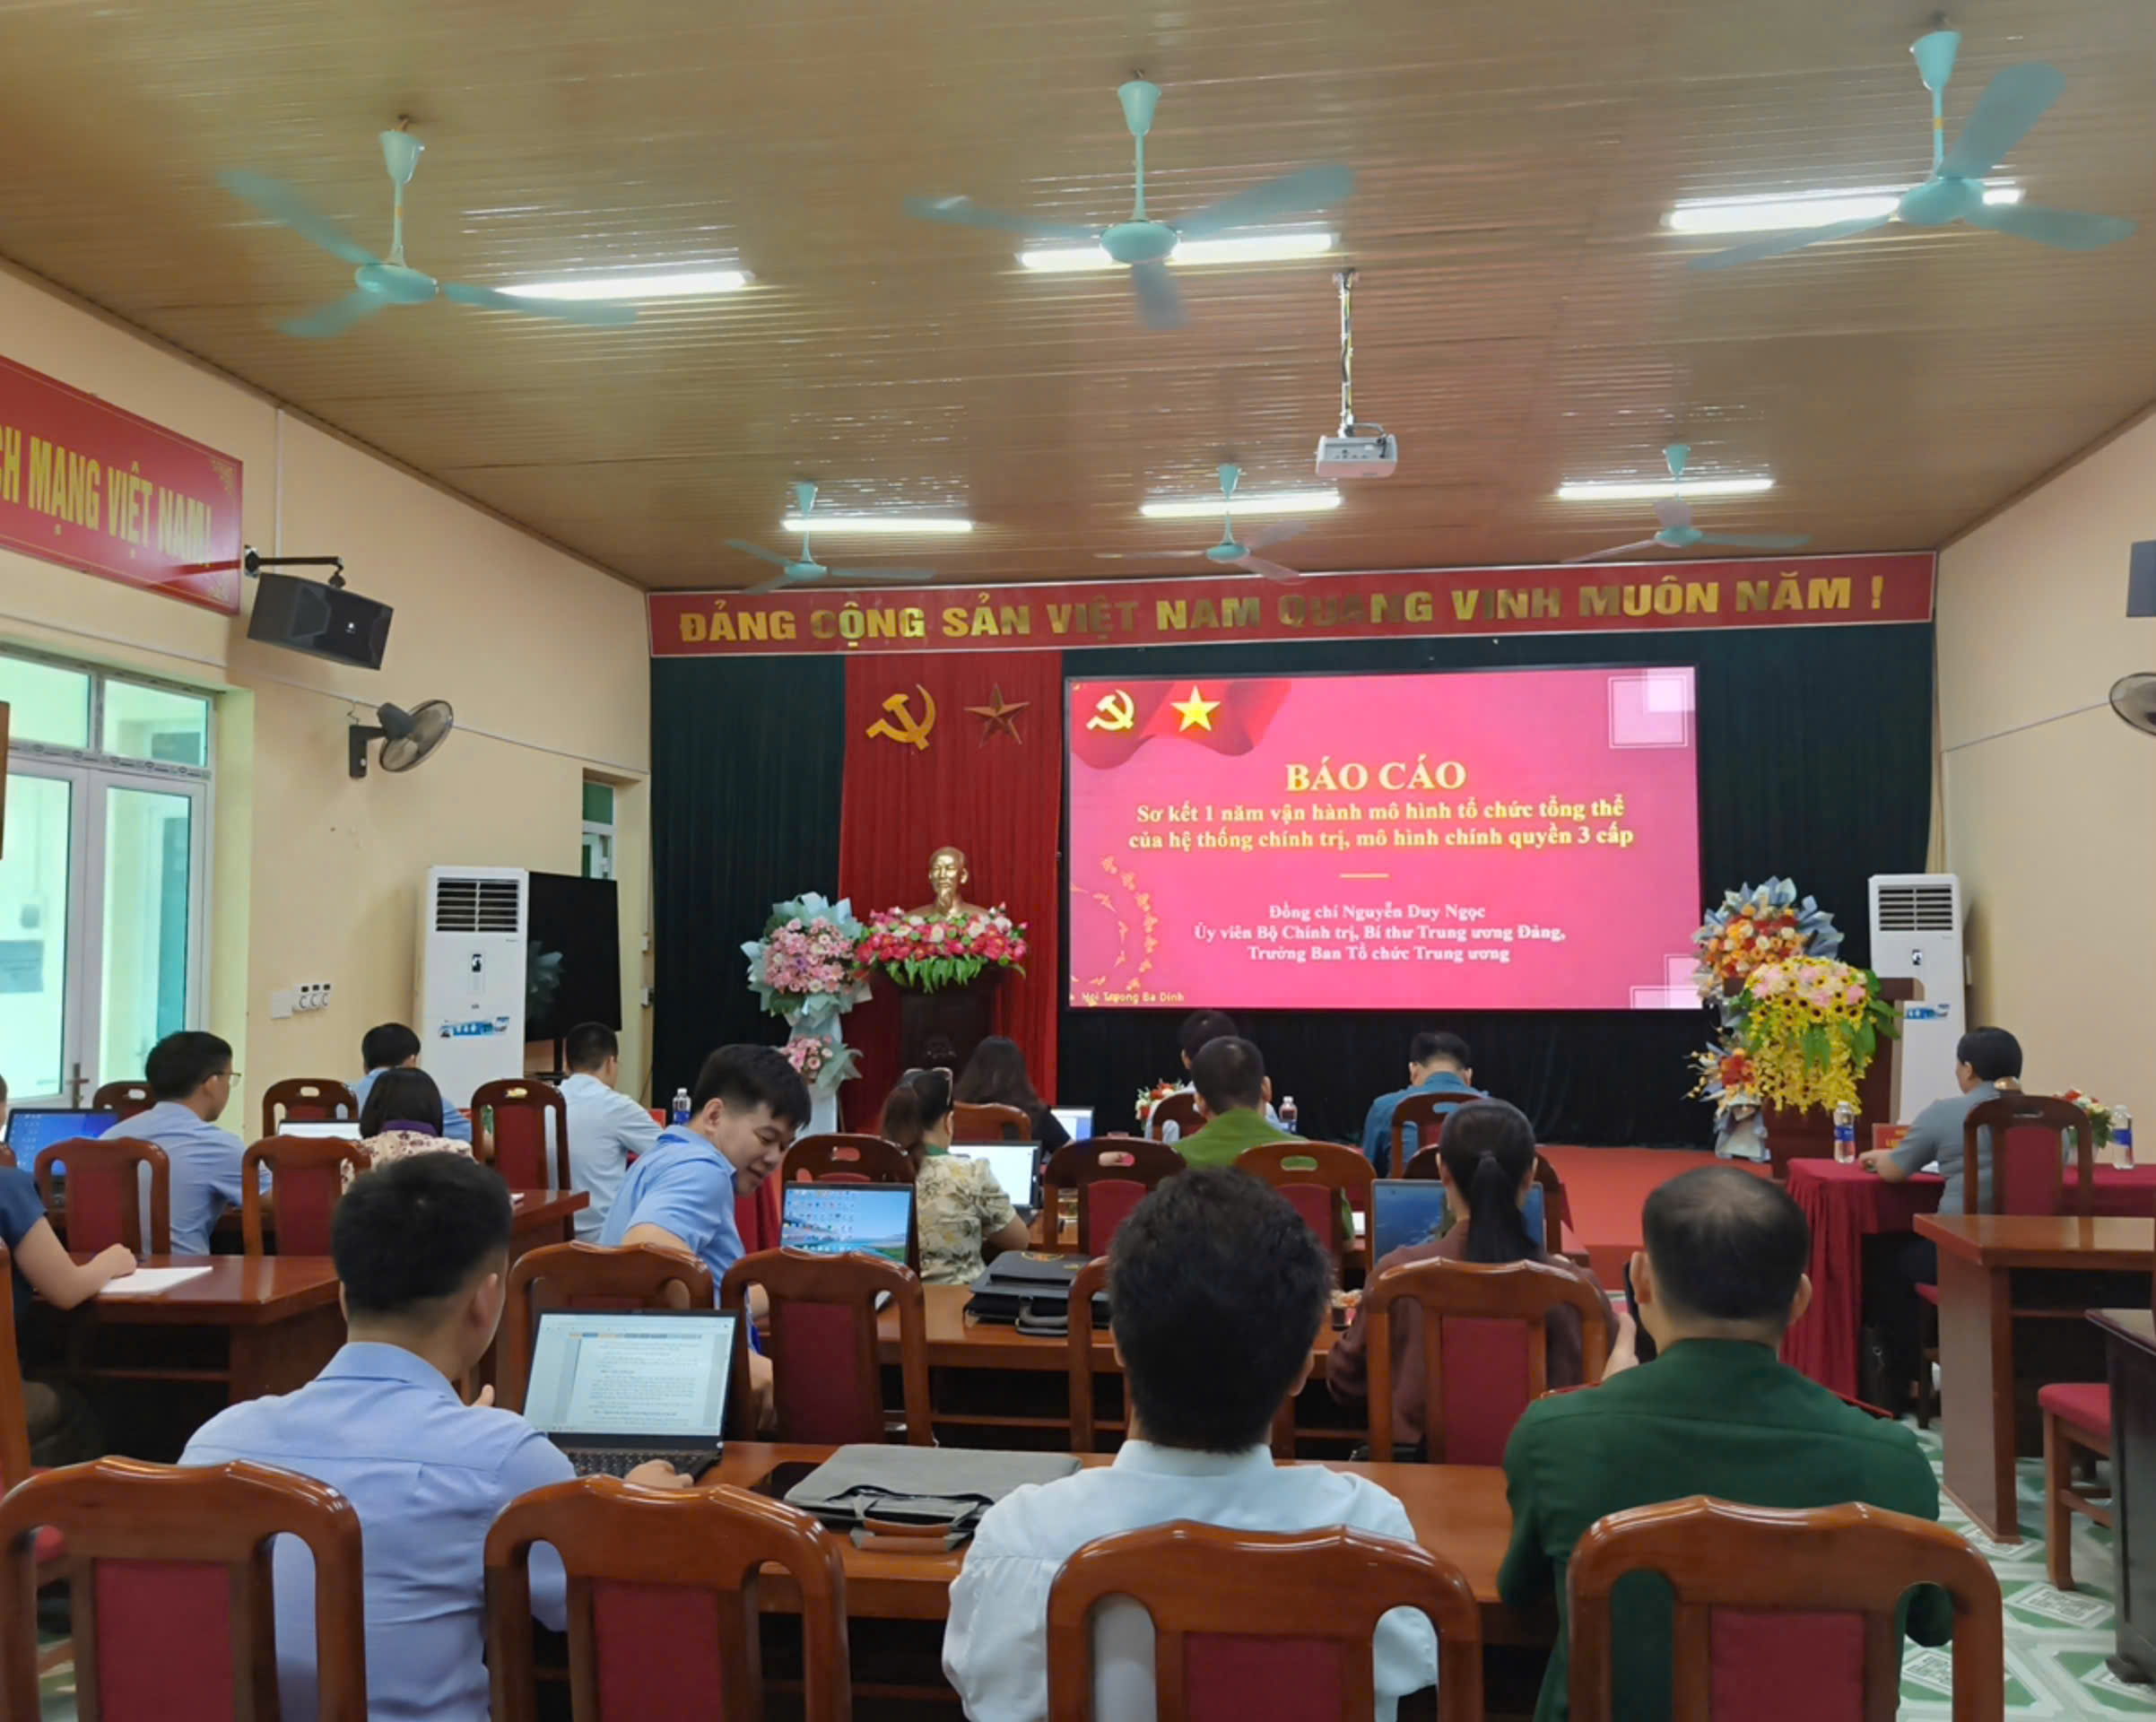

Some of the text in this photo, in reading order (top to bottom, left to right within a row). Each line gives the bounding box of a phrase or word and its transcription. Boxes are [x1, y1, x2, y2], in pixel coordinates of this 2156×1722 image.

[0, 424, 22, 504] H
[28, 436, 100, 535] MẠNG
[107, 460, 152, 559] VIỆT
[680, 570, 1885, 647] ĐẢNG CỘNG SẢN VIỆT NAM QUANG VINH MUÔN NĂM !
[1285, 754, 1466, 792] BÁO CÁO
[1136, 794, 1625, 825] Sơ kết 1 năm vận hành mô hình tổ chức tổng thể
[1128, 831, 1163, 848] của
[1169, 829, 1192, 852] hệ
[1197, 827, 1253, 852] thống
[1258, 828, 1313, 848] chính
[1320, 830, 1351, 851] trị,
[1357, 830, 1387, 847] mô
[1445, 827, 1502, 846] chính
[1508, 822, 1572, 849] quyền
[1578, 826, 1591, 844] 3
[1595, 822, 1634, 848] cấp
[1269, 900, 1486, 922] Đồng chí Nguyễn Duy Ngọc
[1220, 925, 1252, 940] viên
[1256, 925, 1278, 943] Bộ
[1282, 925, 1331, 940] Chính
[1334, 926, 1360, 943] trị,
[1363, 925, 1382, 940] Bí
[1385, 925, 1414, 939] thư
[1417, 925, 1467, 944] Trung
[1471, 927, 1514, 943] ương
[1248, 944, 1510, 965] Trưởng Ban Tổ chức Trung ương
